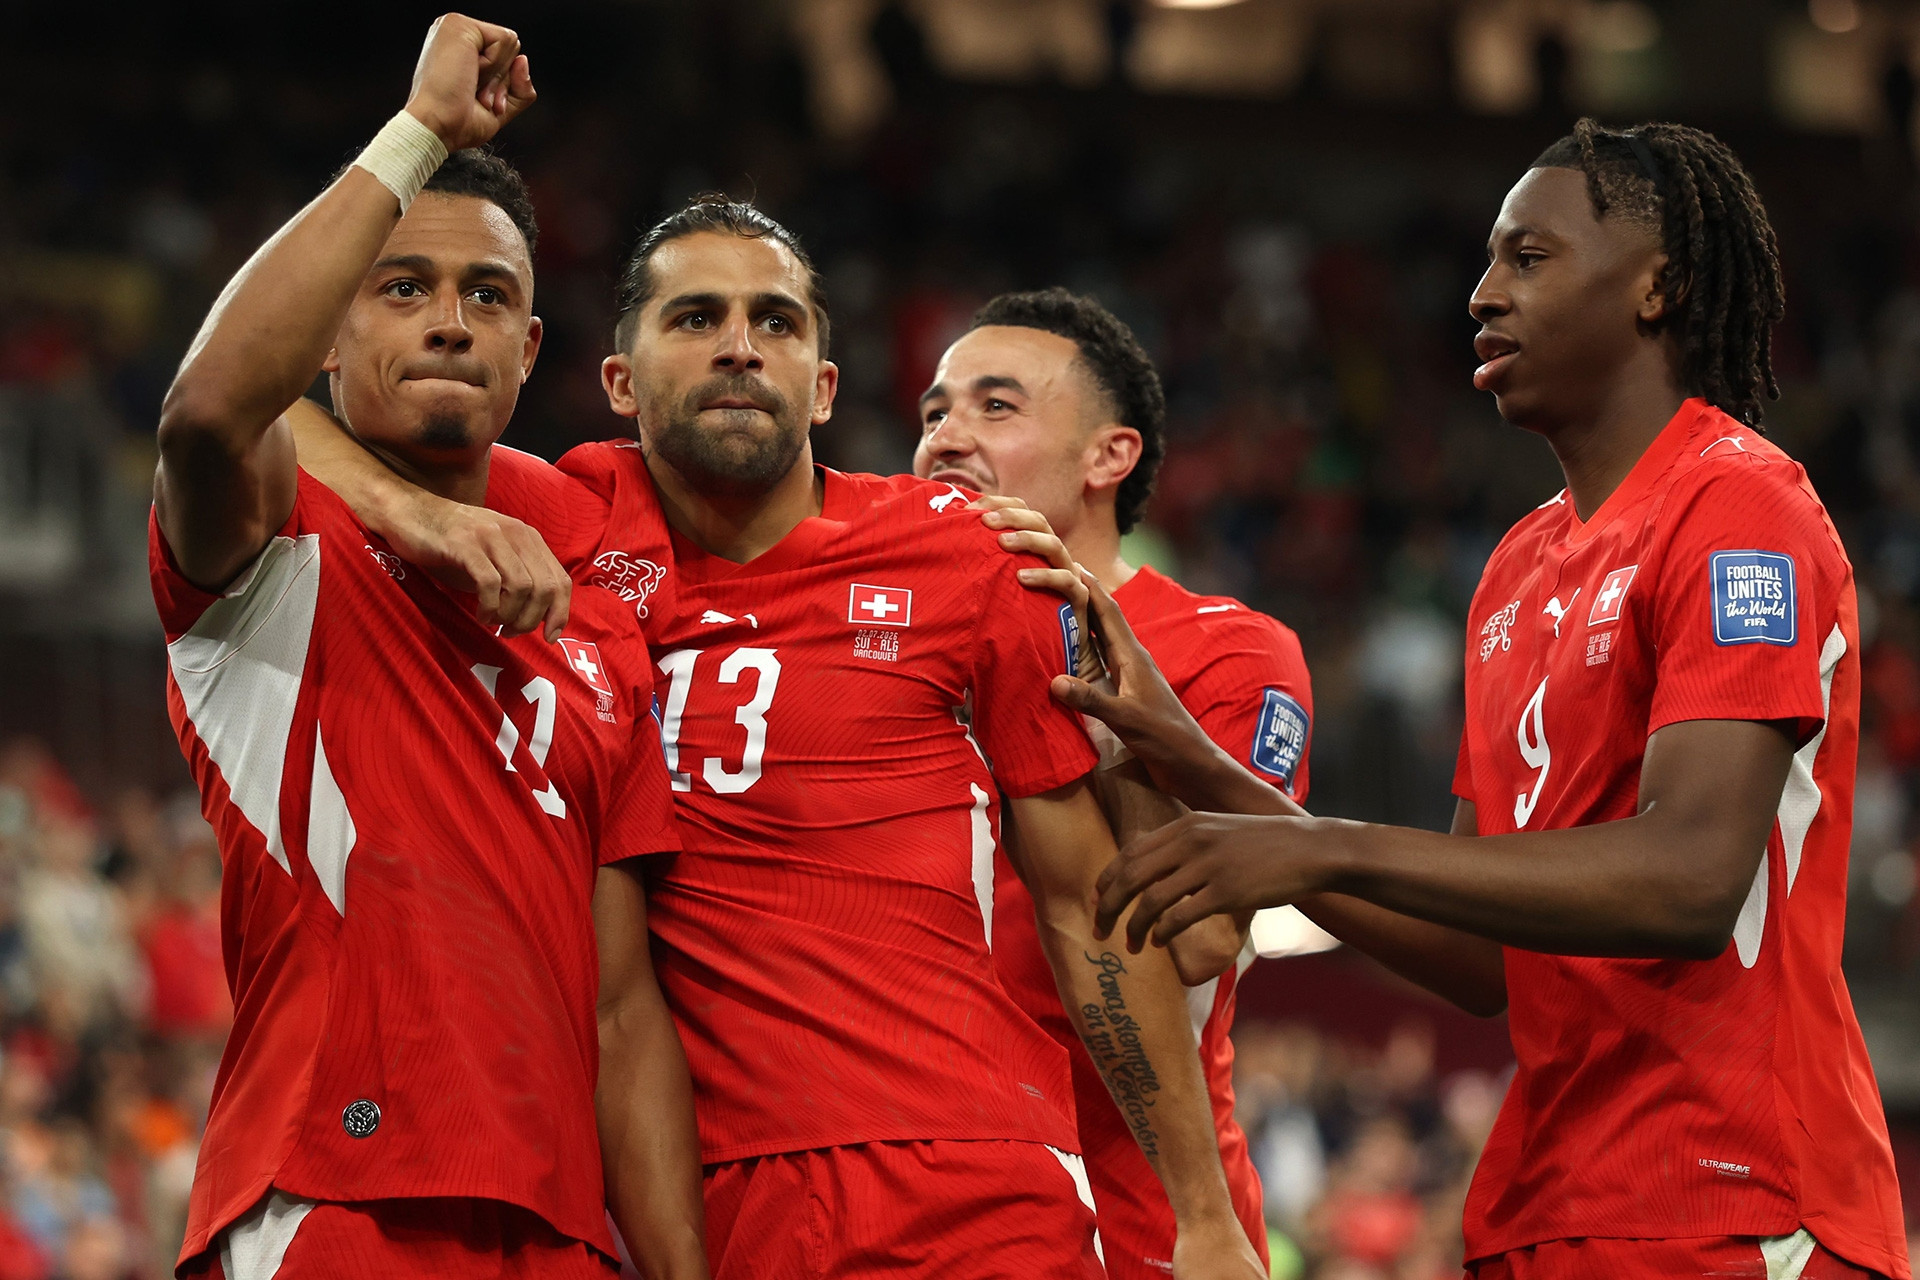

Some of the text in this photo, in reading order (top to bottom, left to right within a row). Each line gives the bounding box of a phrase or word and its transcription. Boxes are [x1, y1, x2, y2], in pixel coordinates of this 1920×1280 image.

[1726, 565, 1782, 580] FOOTBALL
[1727, 579, 1783, 600] UNITES
[1724, 600, 1787, 619] the World
[1744, 618, 1769, 627] FIFA
[858, 629, 899, 640] 02.07.2026
[854, 637, 871, 649] SUI
[880, 639, 899, 652] ALG
[853, 649, 897, 661] VANCOUVER
[657, 647, 782, 794] 13
[1514, 674, 1550, 829] 9
[1084, 950, 1128, 1011] Para
[1082, 1003, 1106, 1030] en
[1698, 1158, 1751, 1174] ULTRAWEAVE
